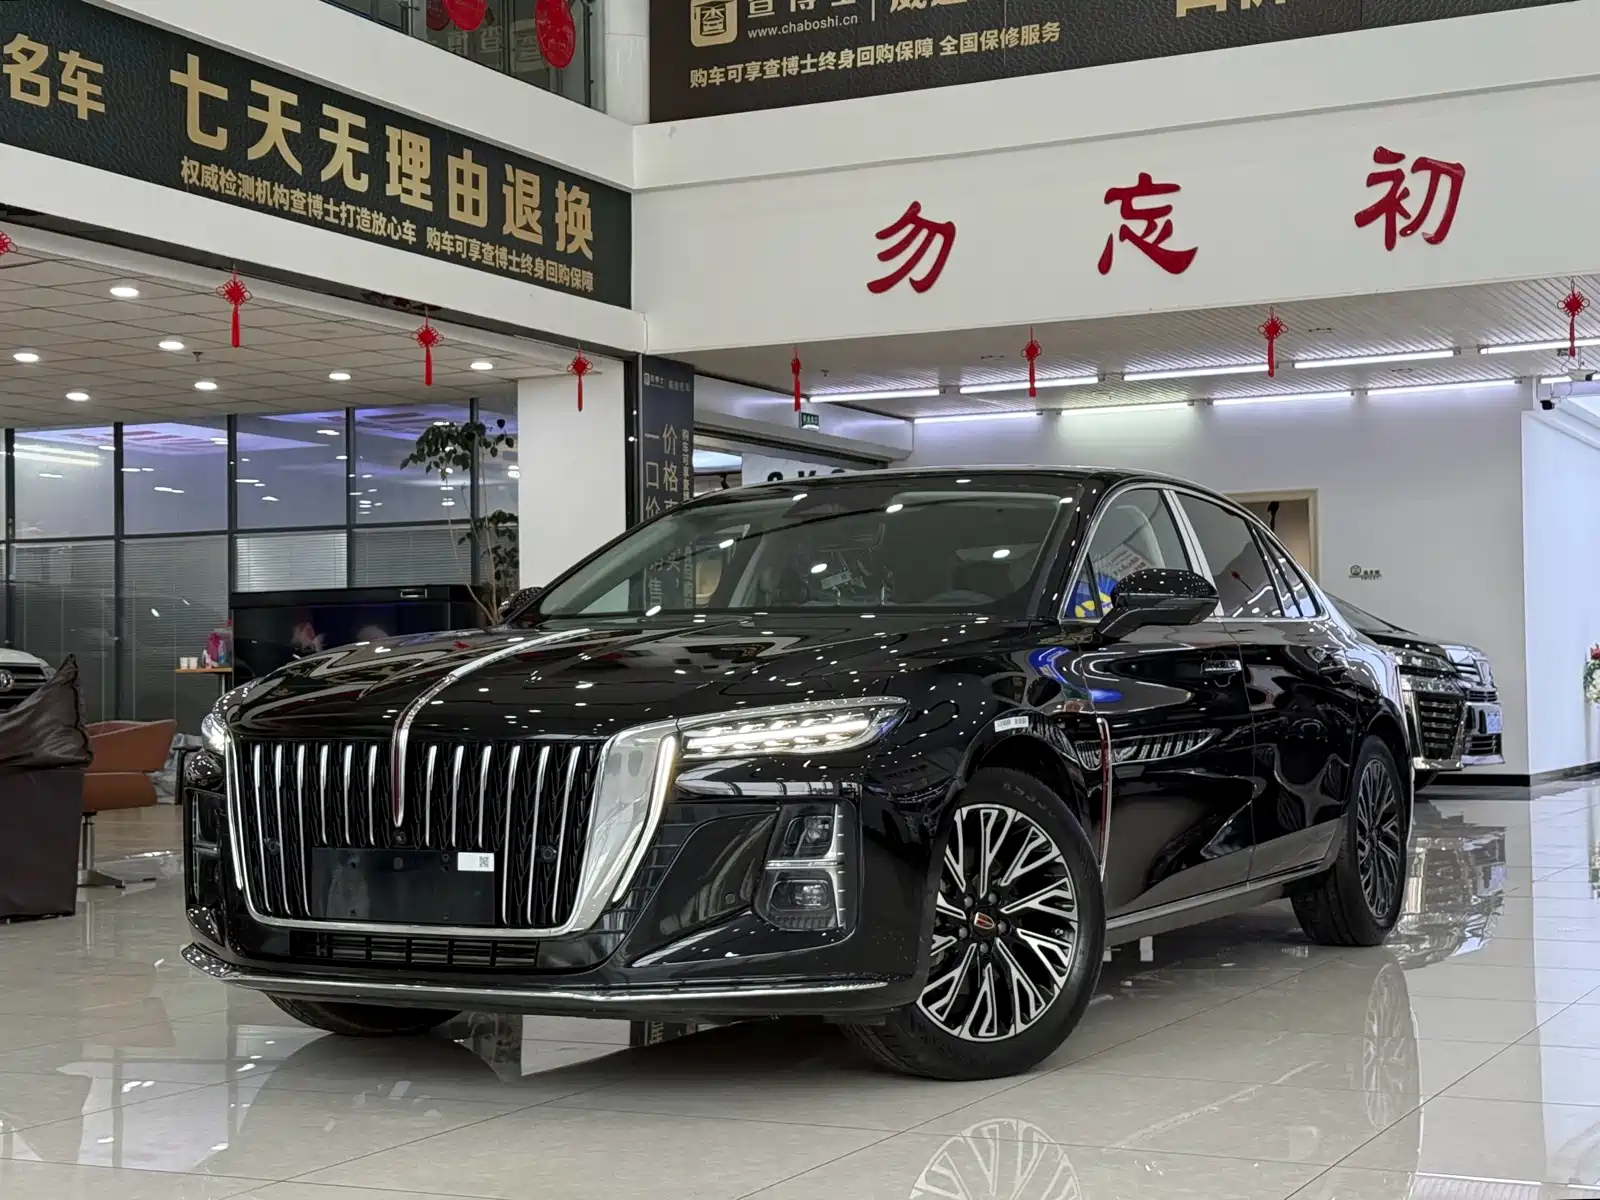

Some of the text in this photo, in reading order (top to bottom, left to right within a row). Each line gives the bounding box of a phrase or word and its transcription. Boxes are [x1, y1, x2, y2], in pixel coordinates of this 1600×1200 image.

[690, 21, 1061, 88] 购车可享查博士终身回购保障 全国保修服务
[748, 15, 858, 38] www.chaboshi.cn
[2, 33, 105, 120] 名车
[170, 53, 593, 261] 七天无理由退换
[180, 155, 594, 293] 权威检测机构查博士打造放心车 购车可享查博士终身回购保障
